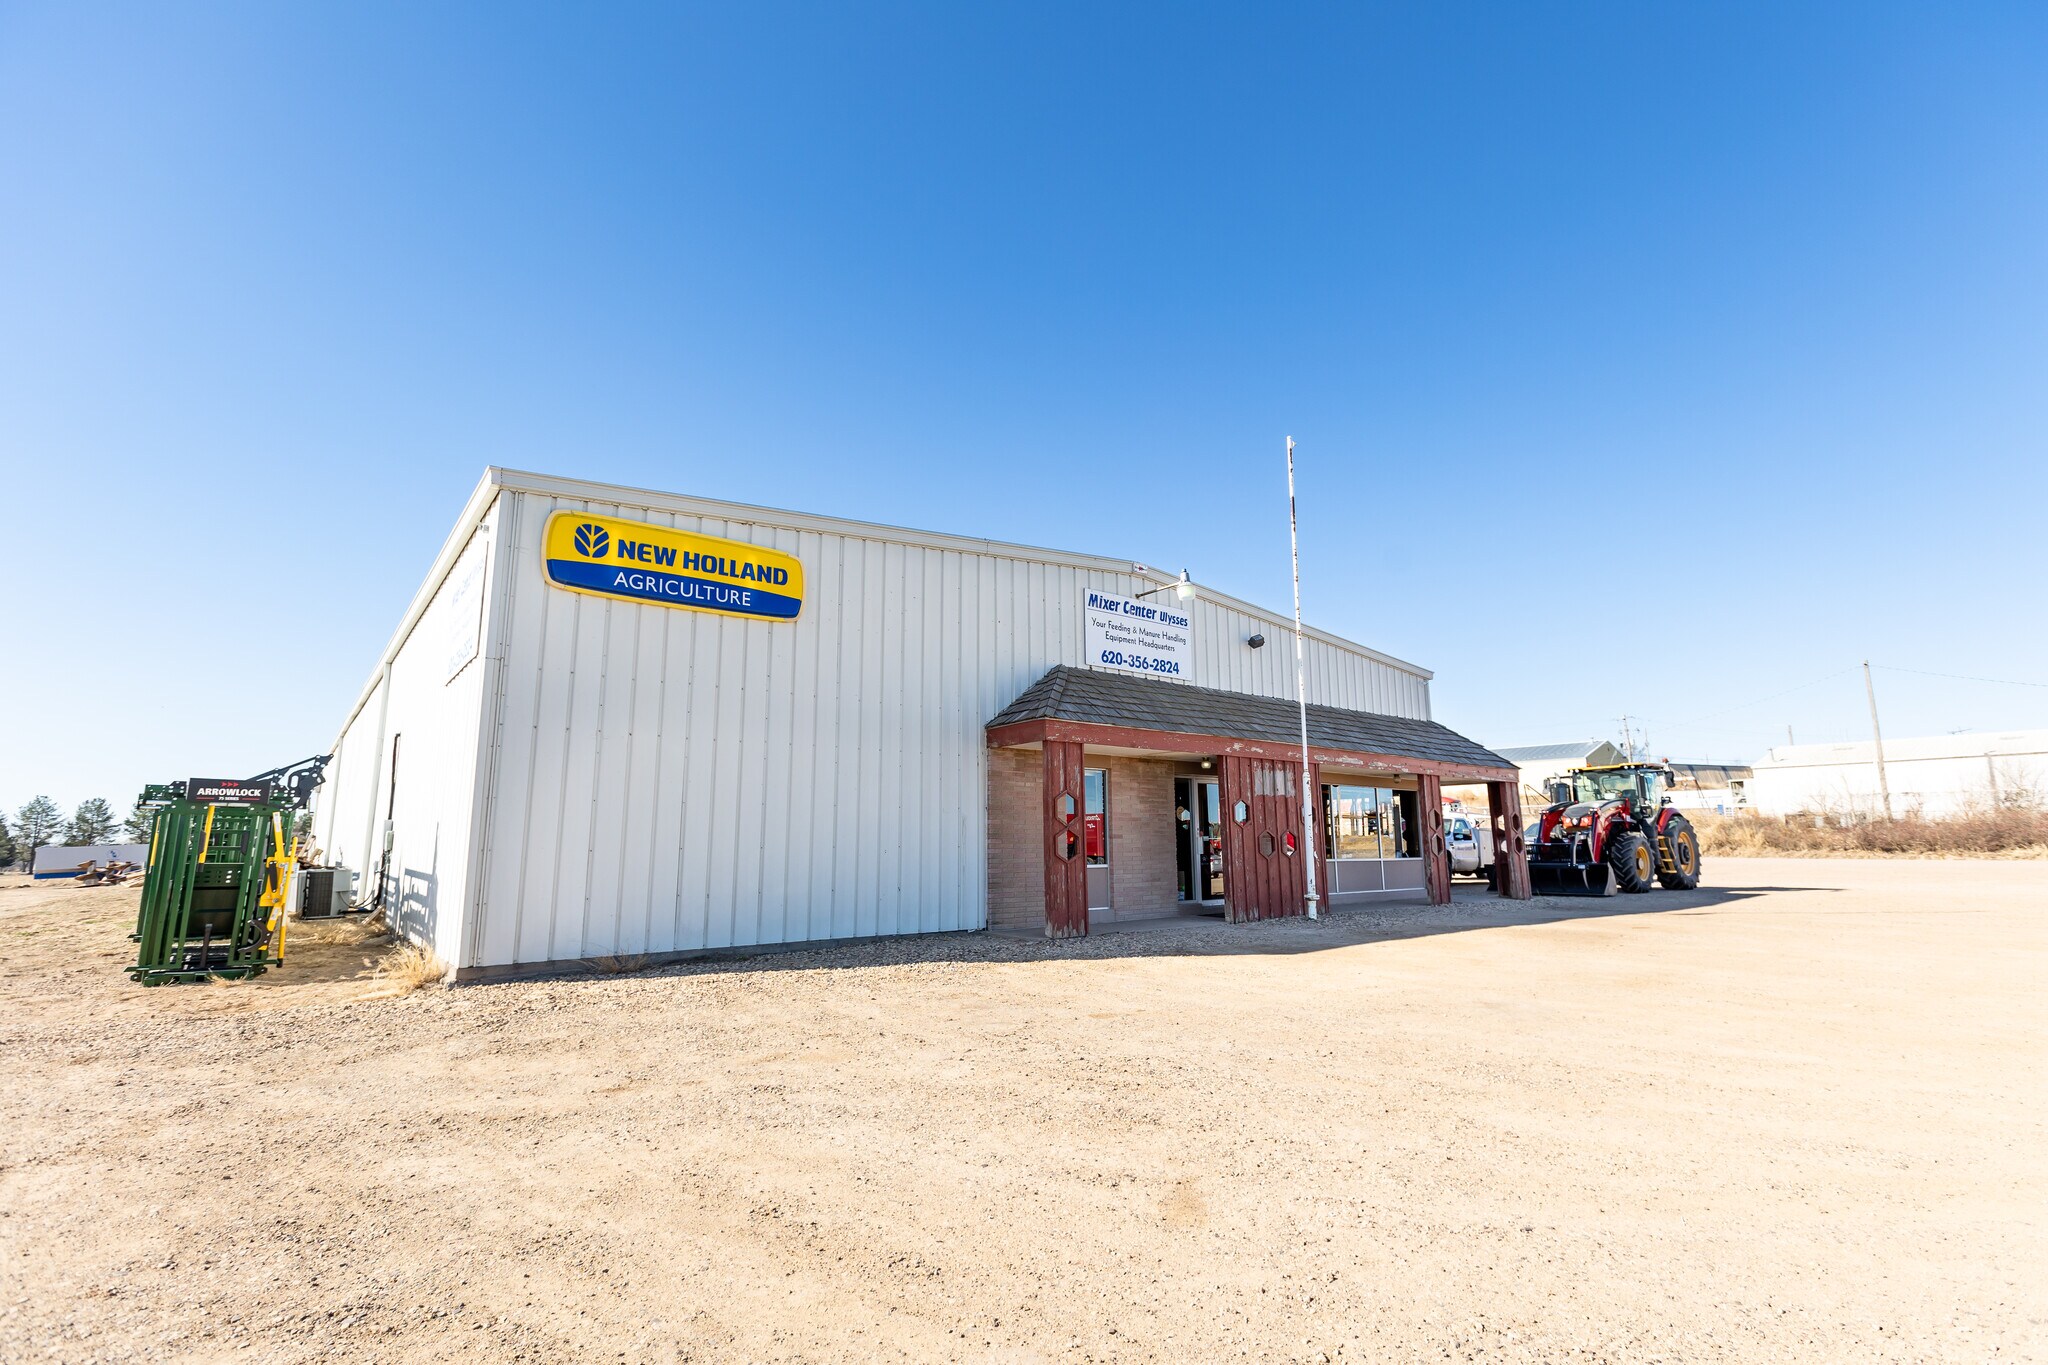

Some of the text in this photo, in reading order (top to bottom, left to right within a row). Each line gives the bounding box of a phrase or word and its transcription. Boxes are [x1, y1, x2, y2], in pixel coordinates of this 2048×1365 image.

[617, 538, 789, 586] NEW HOLLAND
[613, 571, 752, 607] AGRICULTURE
[1087, 593, 1188, 627] Mixer Center Ulysses
[1091, 617, 1187, 646] Your Feeding & Manure Handling
[1105, 631, 1175, 652] Equipment Headquarters
[1101, 649, 1180, 675] 620-356-2824
[196, 787, 262, 797] ARROWLOCK
